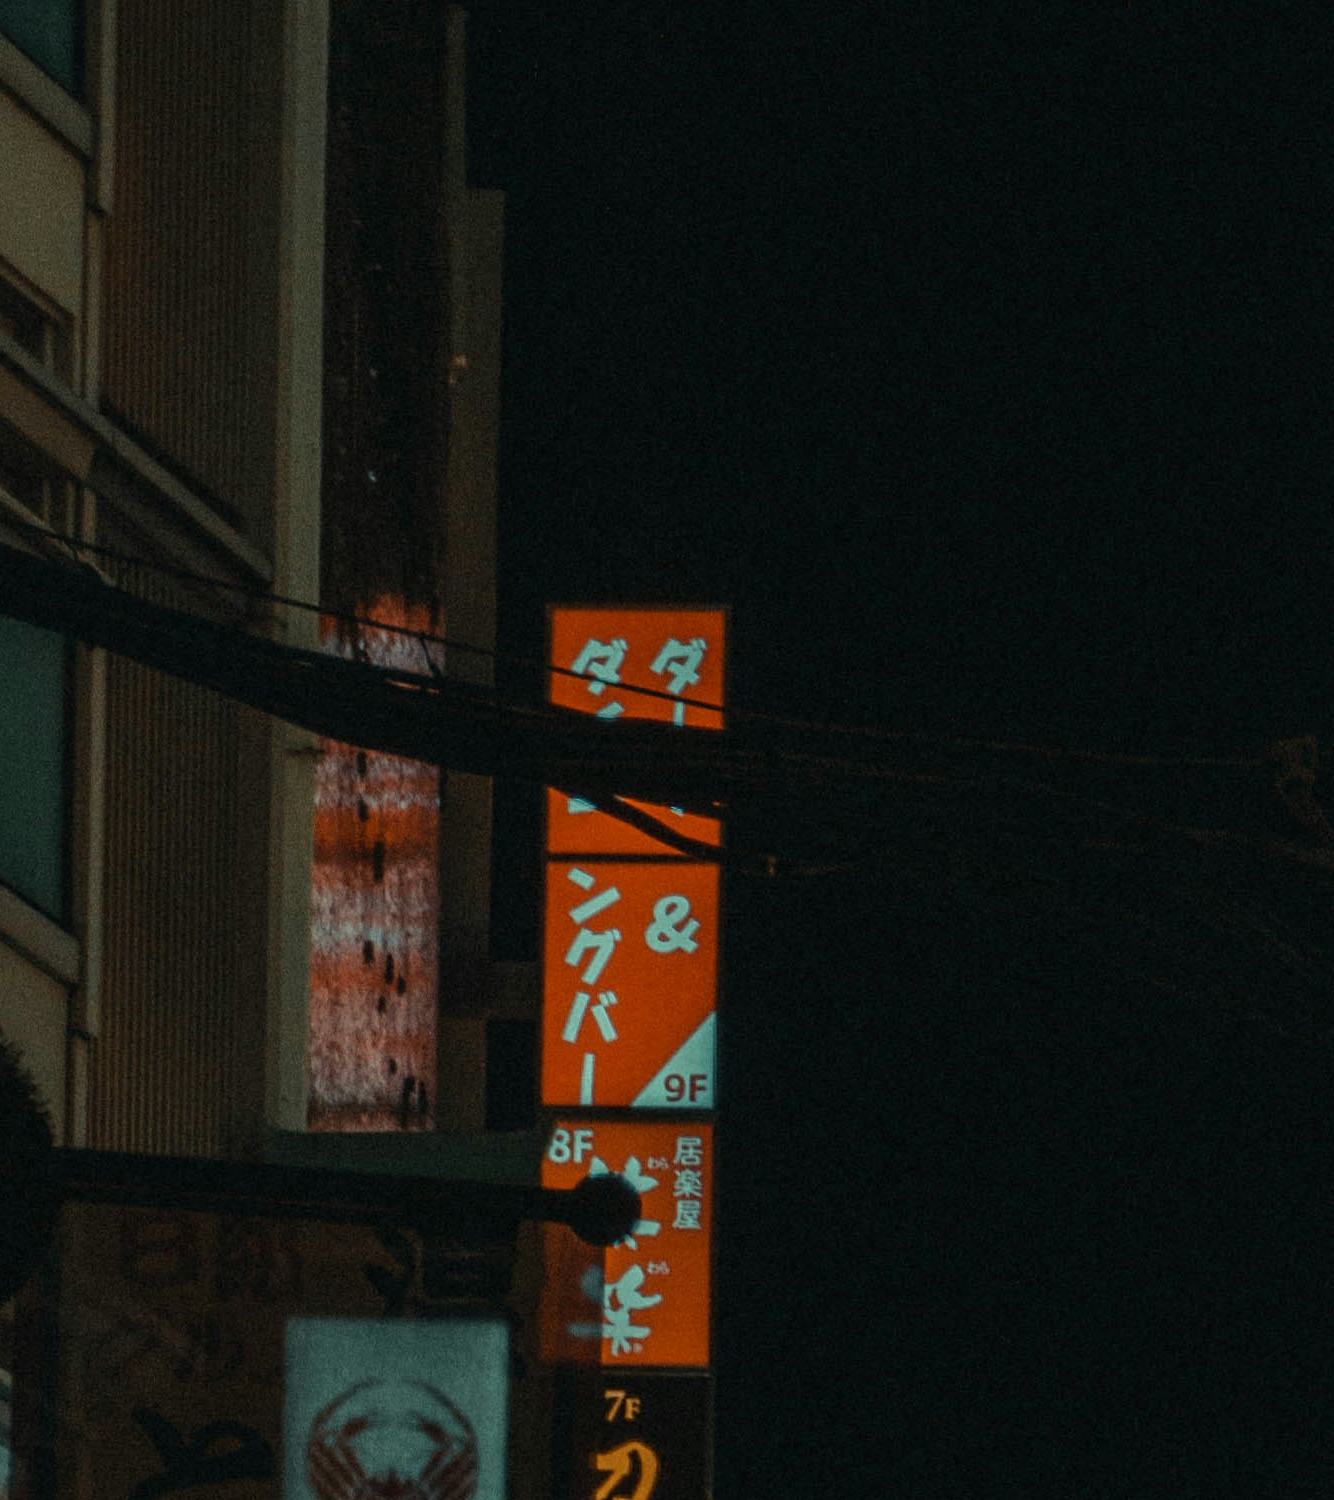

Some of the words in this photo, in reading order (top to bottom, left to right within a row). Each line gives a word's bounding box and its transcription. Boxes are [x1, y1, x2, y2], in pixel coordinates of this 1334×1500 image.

[563, 636, 628, 1105] ダングバー
[665, 1074, 707, 1102] 9F
[547, 1129, 594, 1163] 8F
[603, 1389, 642, 1423] 7F
